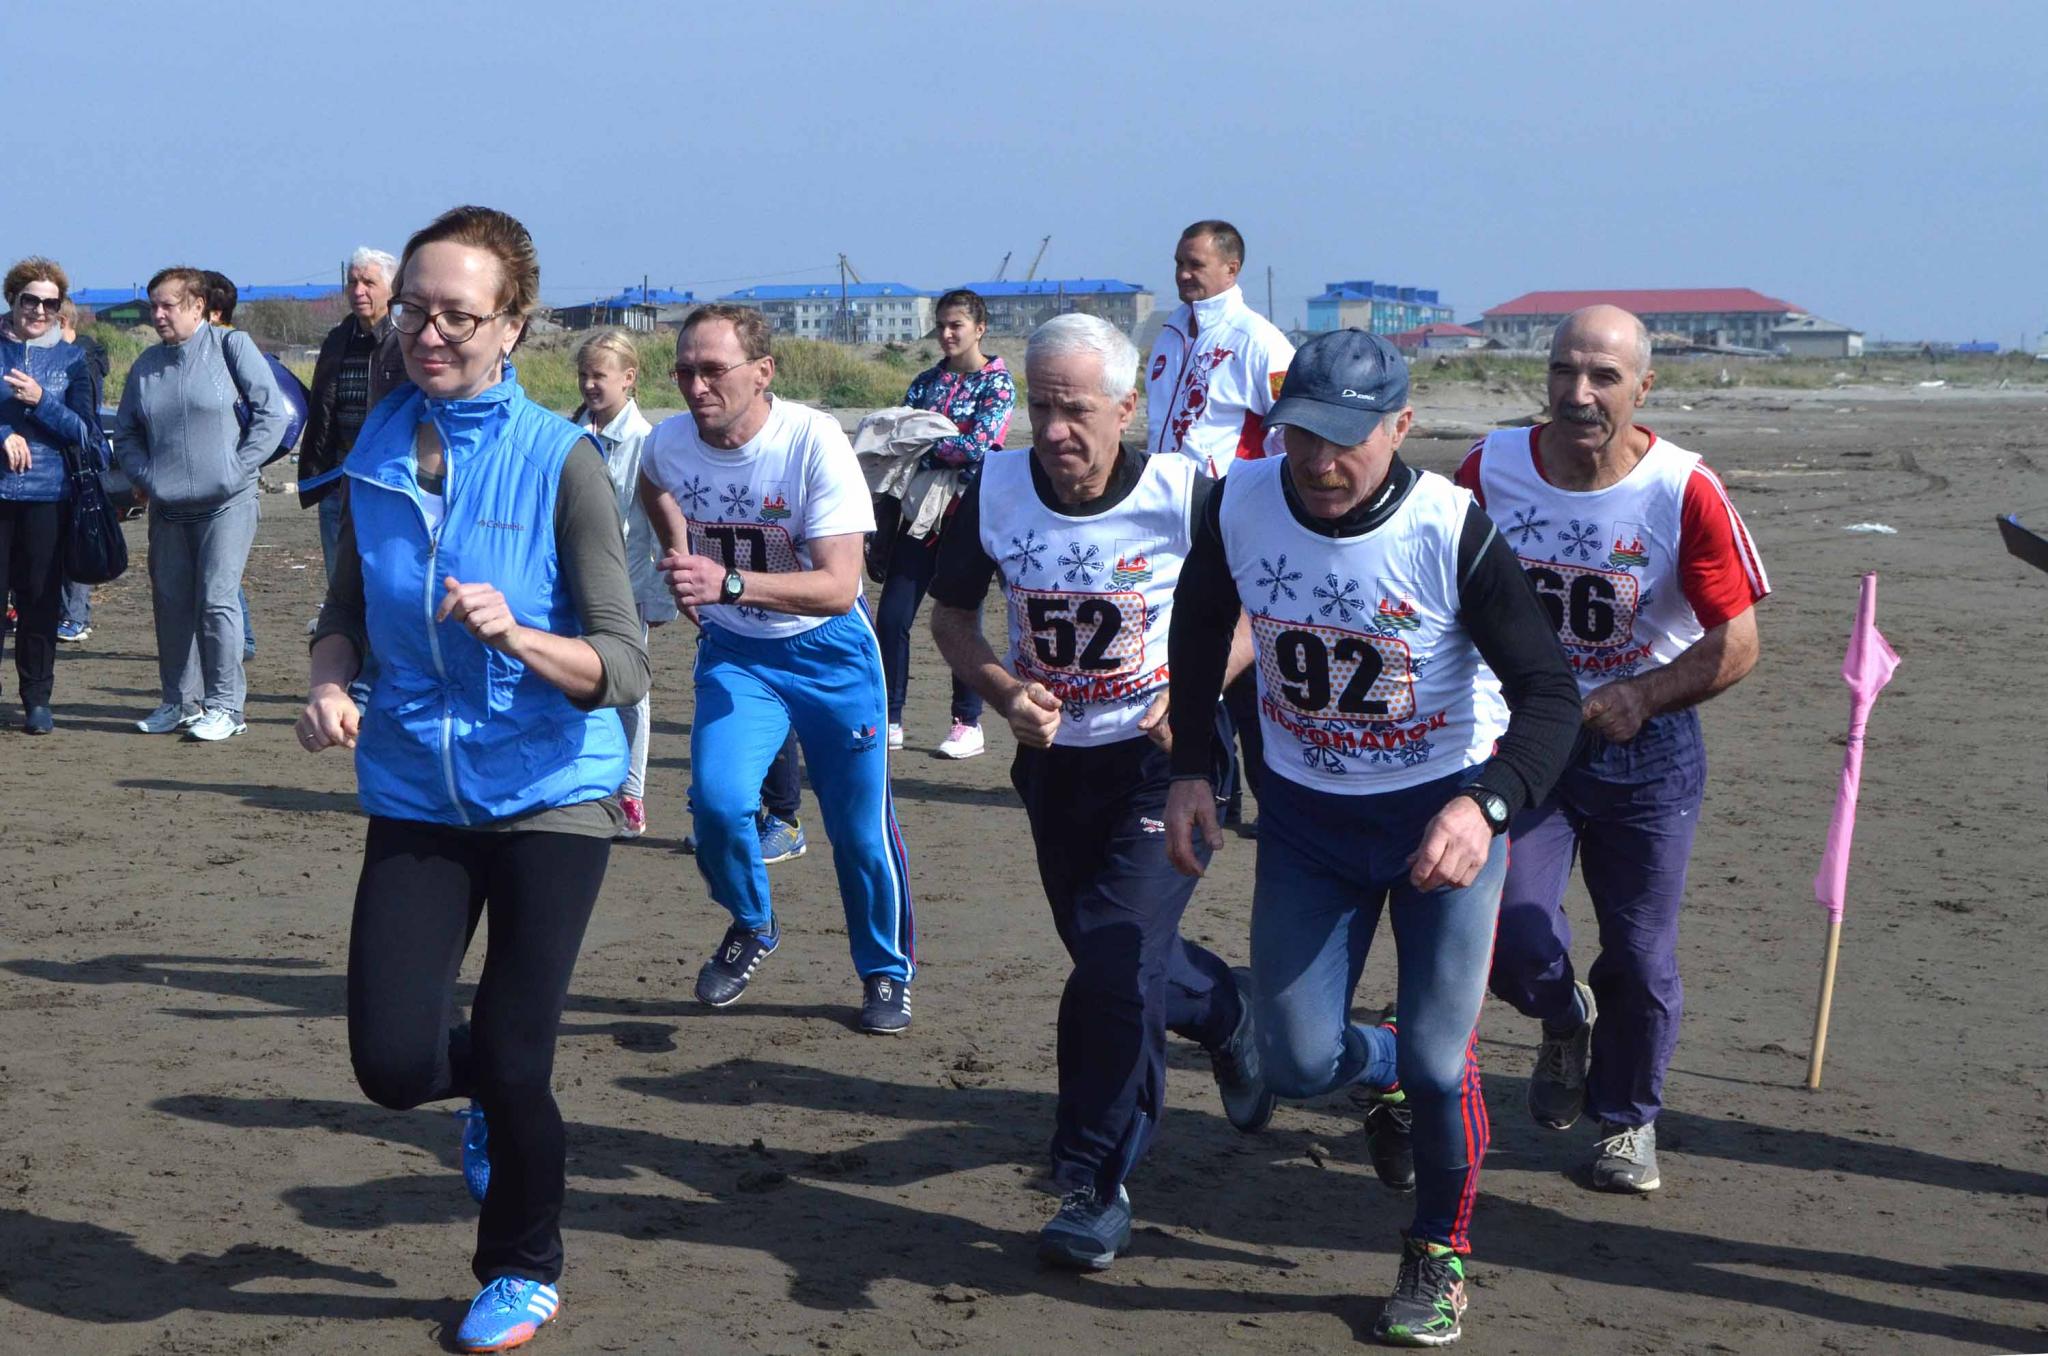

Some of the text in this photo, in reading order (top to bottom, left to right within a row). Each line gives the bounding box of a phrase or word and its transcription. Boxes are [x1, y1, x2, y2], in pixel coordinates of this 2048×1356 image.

[1027, 598, 1123, 670] 52
[1526, 567, 1617, 643] 66
[1275, 629, 1389, 715] 92
